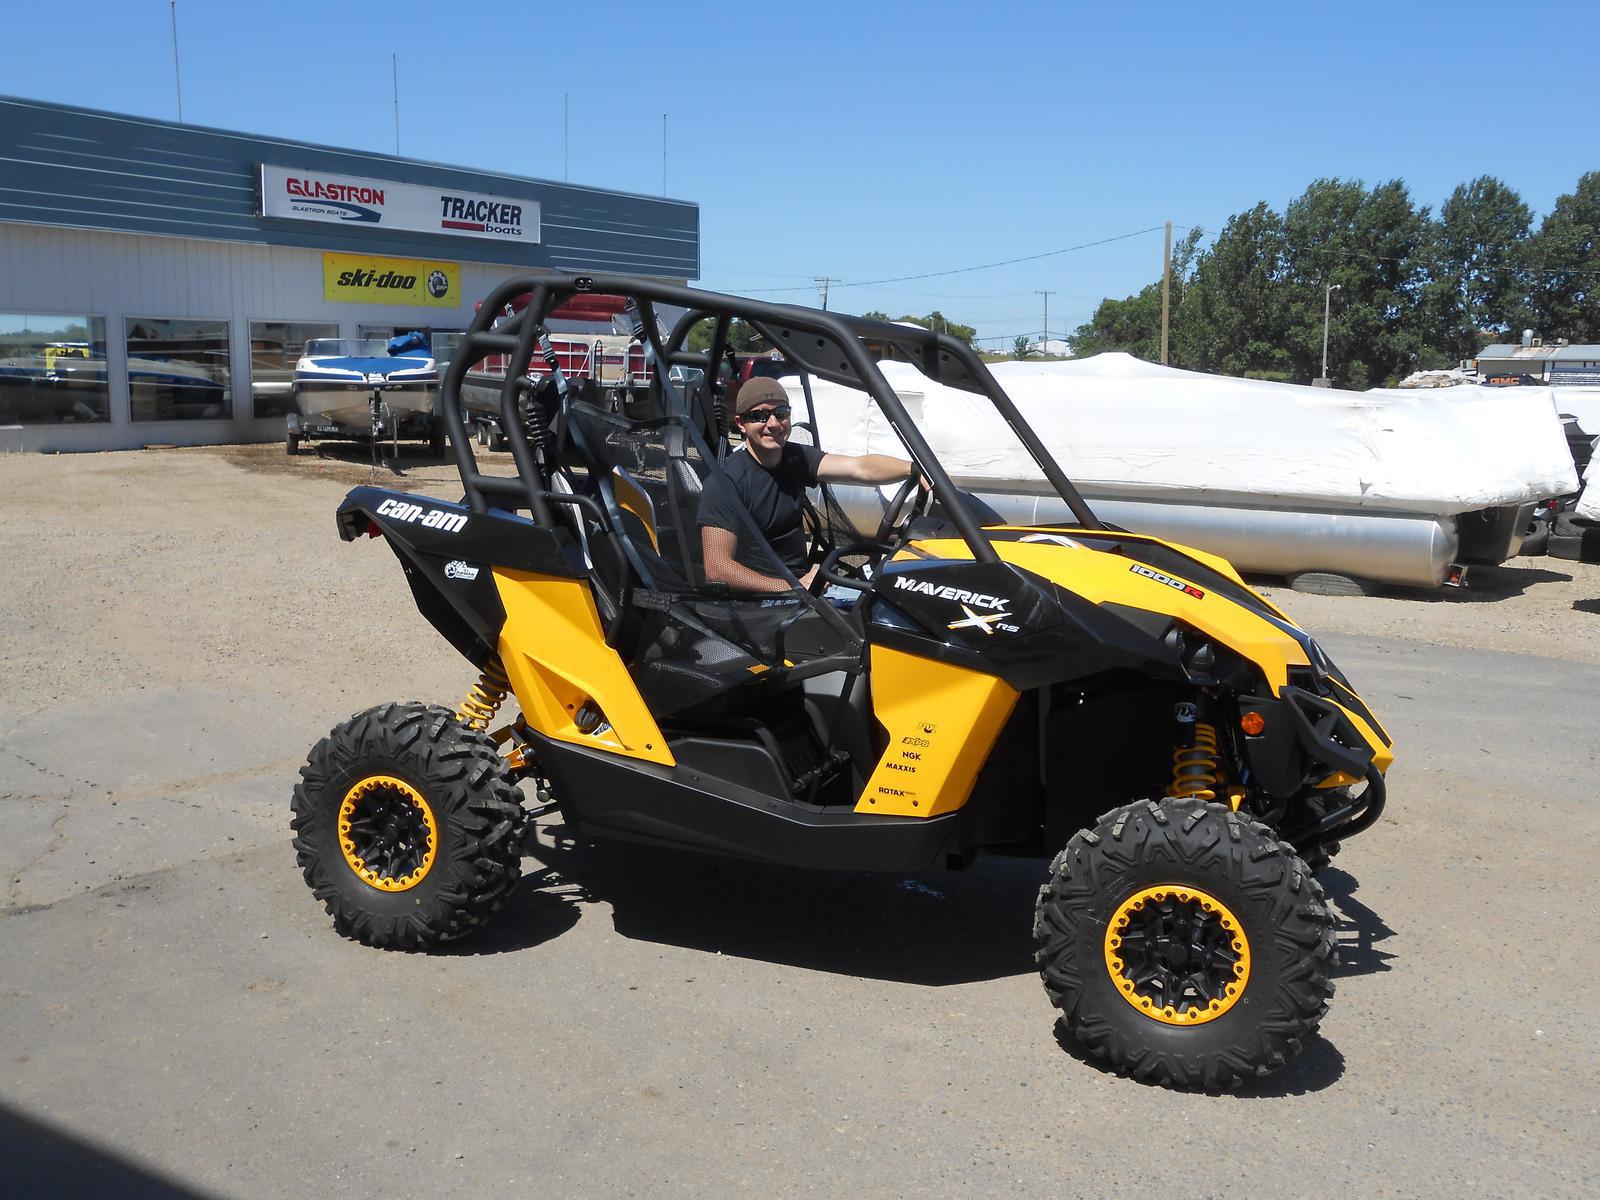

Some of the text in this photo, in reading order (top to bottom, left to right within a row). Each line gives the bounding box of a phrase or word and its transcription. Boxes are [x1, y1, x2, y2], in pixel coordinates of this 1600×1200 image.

[286, 177, 385, 206] GLASTRON
[292, 205, 326, 214] GLASTRON
[441, 196, 522, 226] TRACKER
[485, 223, 523, 236] boats
[337, 268, 417, 290] ski-doo
[1490, 377, 1520, 385] GMC
[376, 499, 468, 533] can-am
[1131, 564, 1204, 599] 1000R
[894, 576, 1010, 612] MAVERICK
[902, 751, 922, 761] NGK
[885, 762, 916, 773] MAXXIS
[878, 786, 905, 797] ROTAX
